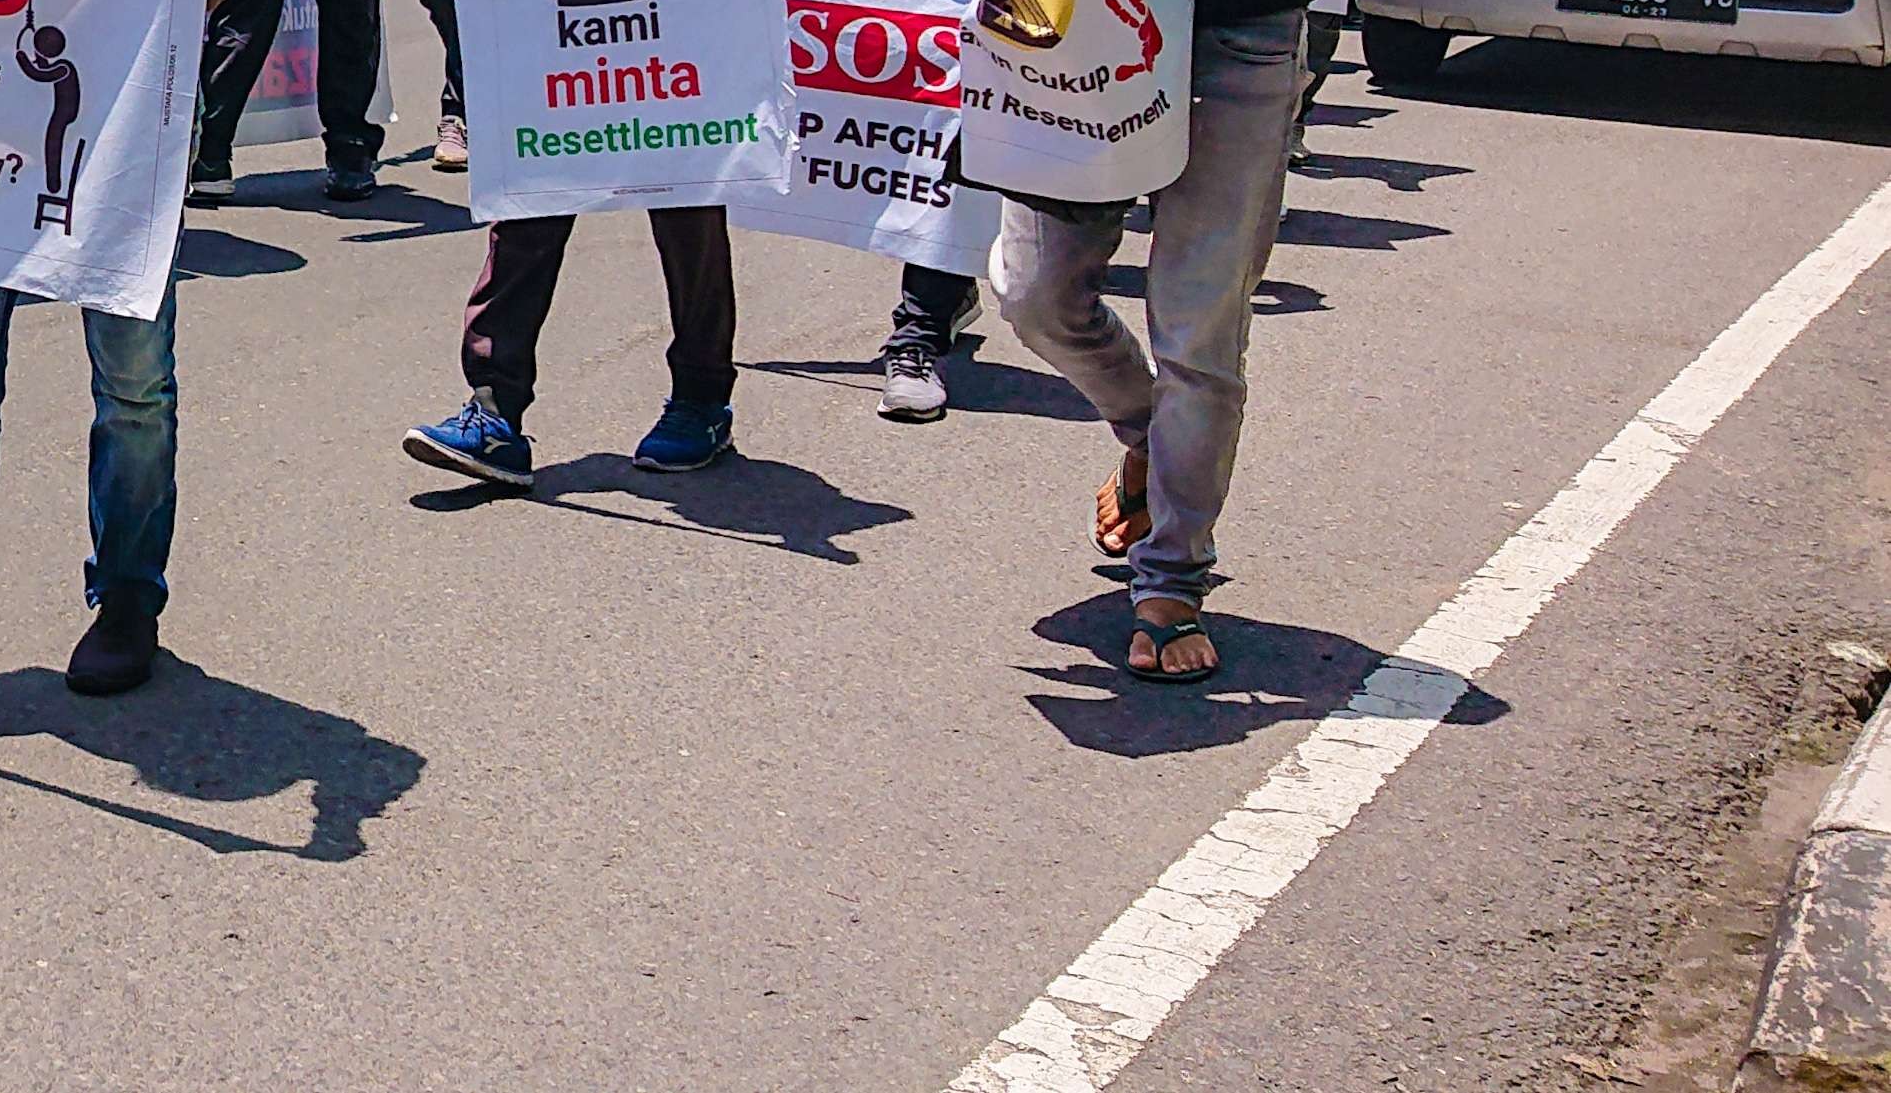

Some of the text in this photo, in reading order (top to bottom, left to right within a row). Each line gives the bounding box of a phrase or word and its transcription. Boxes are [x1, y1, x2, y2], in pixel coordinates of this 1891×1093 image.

[557, 1, 661, 48] kami
[788, 9, 961, 93] SOS
[546, 57, 701, 108] minta
[1019, 65, 1110, 94] Cukup
[515, 112, 759, 159] Resettlement
[1001, 89, 1171, 144] Resettlement
[801, 155, 953, 209] FUGEES
